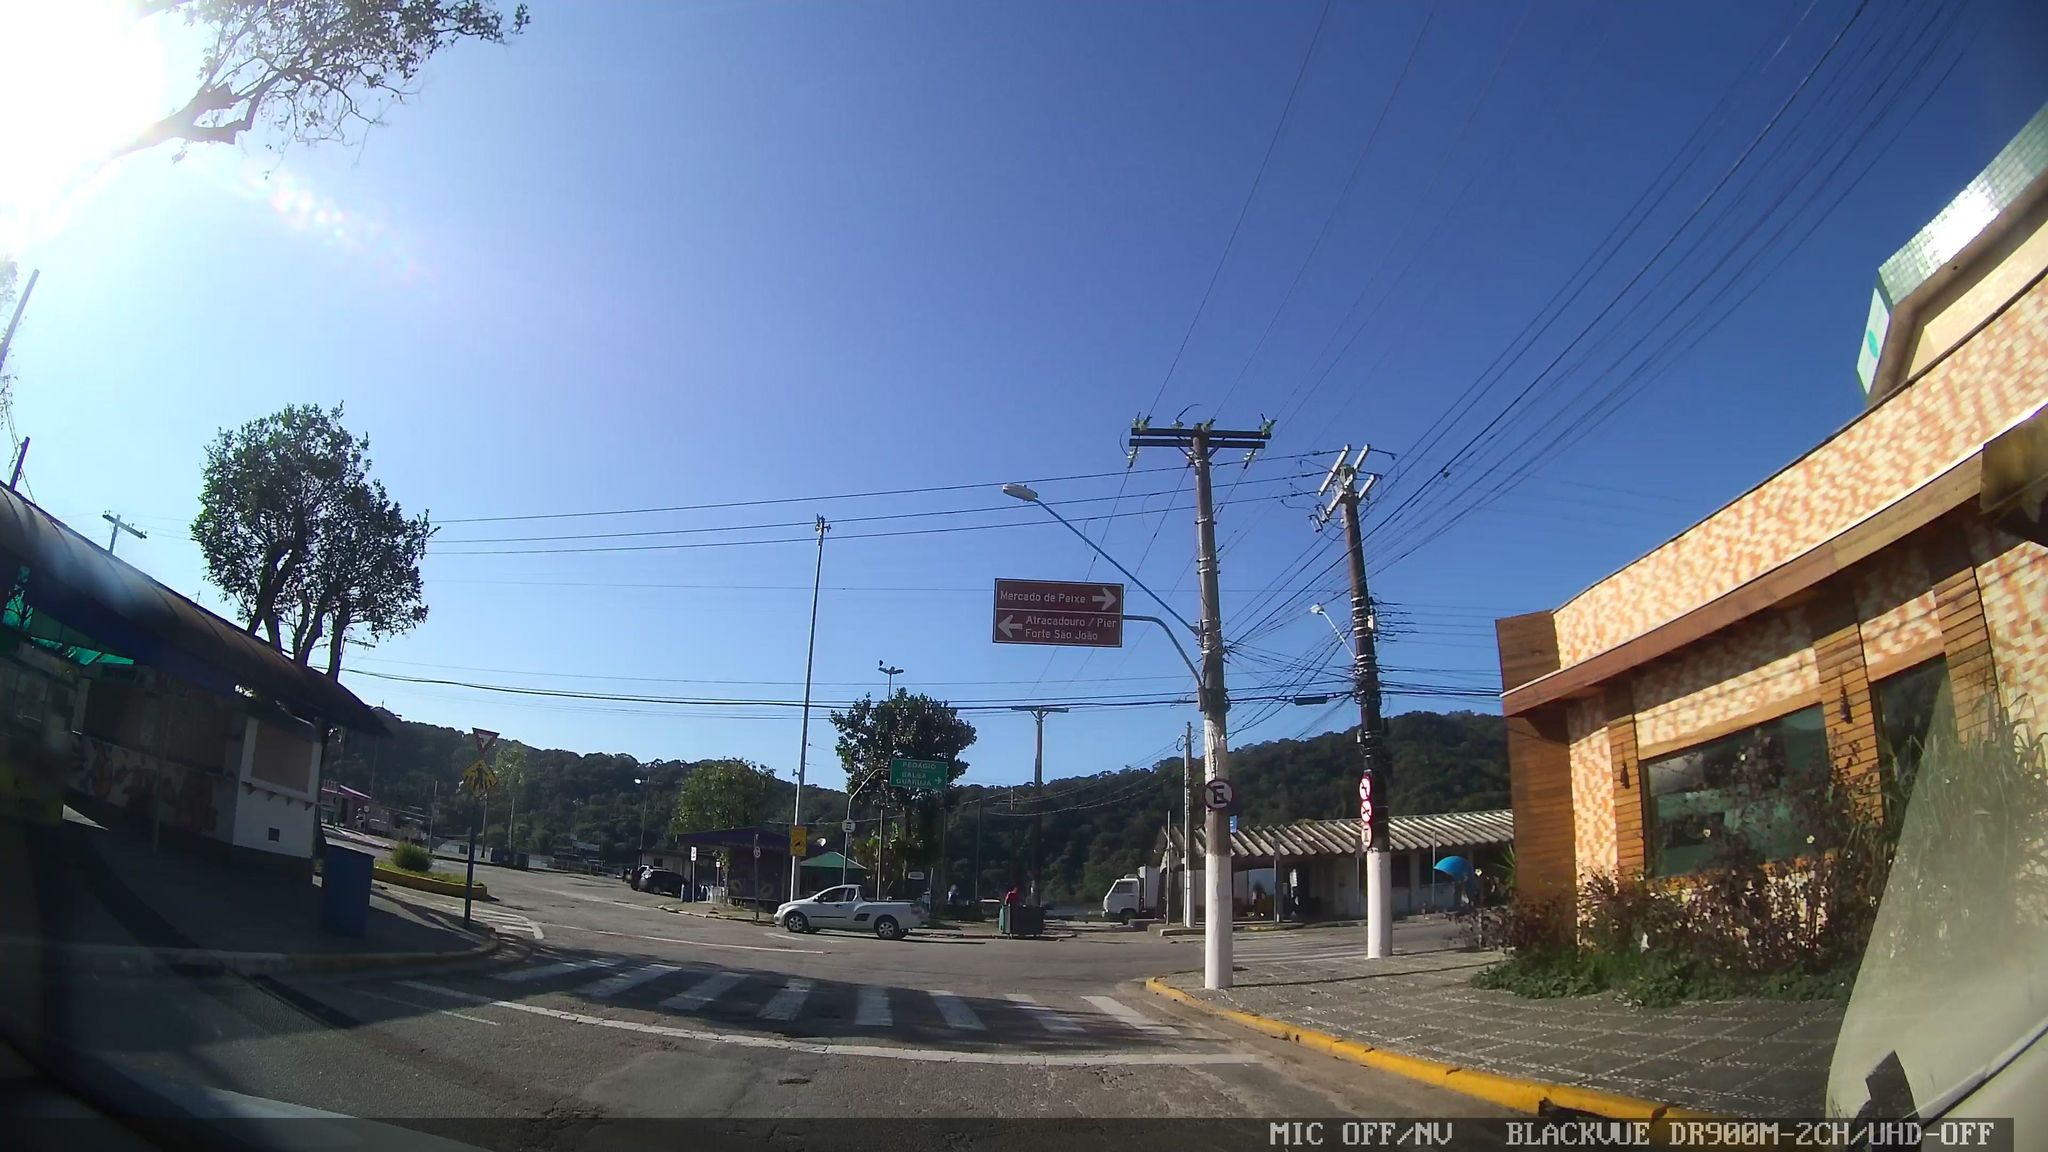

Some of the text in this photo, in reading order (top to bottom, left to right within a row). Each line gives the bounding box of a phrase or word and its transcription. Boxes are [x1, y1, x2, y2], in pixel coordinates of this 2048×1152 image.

[1000, 590, 1086, 604] Mercado de Peixe
[1025, 615, 1117, 628] Atracadouro / Pier
[1025, 628, 1098, 640] Forte São João
[1213, 785, 1227, 804] E
